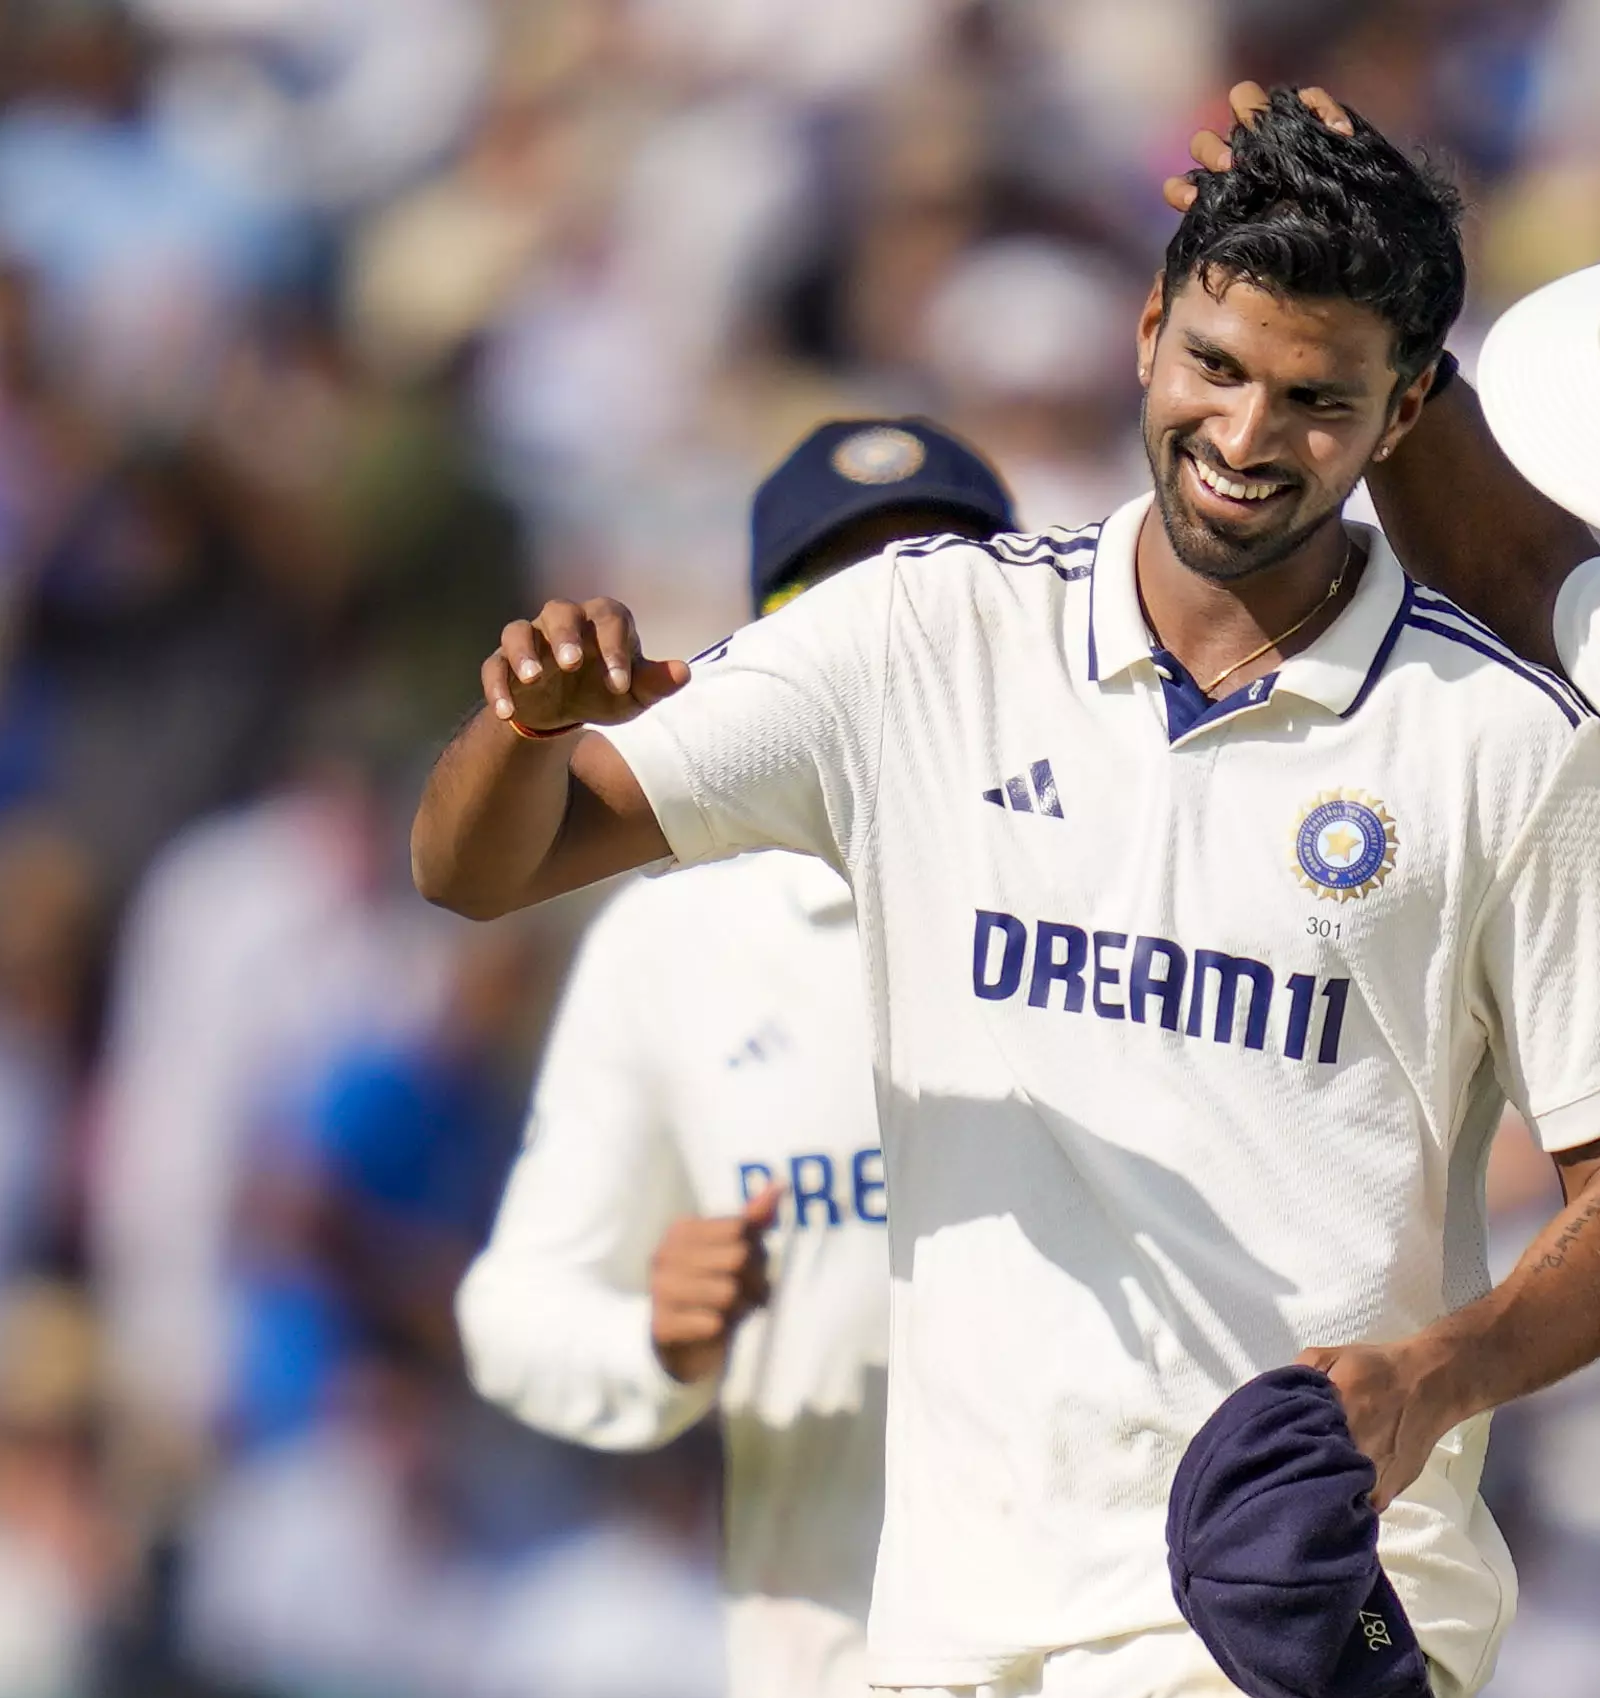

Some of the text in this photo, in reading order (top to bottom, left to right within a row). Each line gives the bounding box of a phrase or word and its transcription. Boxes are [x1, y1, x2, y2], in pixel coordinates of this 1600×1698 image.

[1305, 916, 1343, 941] 301
[972, 908, 1350, 1064] DREAM11
[1358, 1610, 1392, 1651] 287
